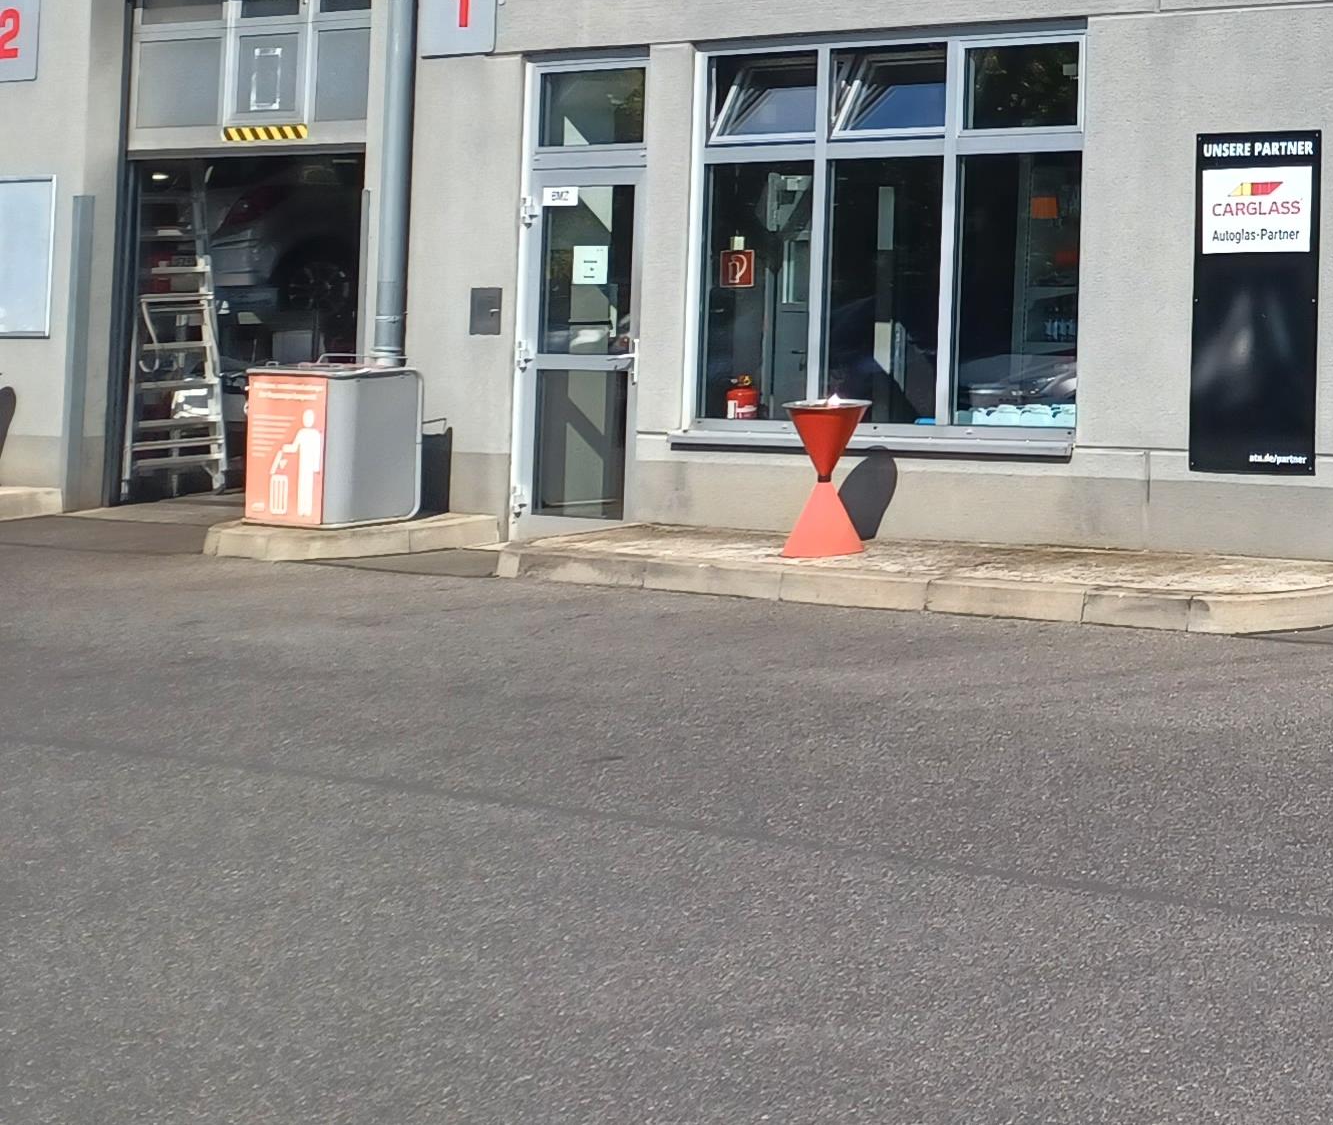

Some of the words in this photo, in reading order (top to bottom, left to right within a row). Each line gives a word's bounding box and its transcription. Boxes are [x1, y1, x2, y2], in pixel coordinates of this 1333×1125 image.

[0, 8, 20, 59] 2
[1203, 142, 1252, 157] UNSERE
[1254, 141, 1314, 156] PARTNER
[1212, 200, 1301, 217] CARGLASS
[1212, 228, 1300, 244] Autoglas-Partner
